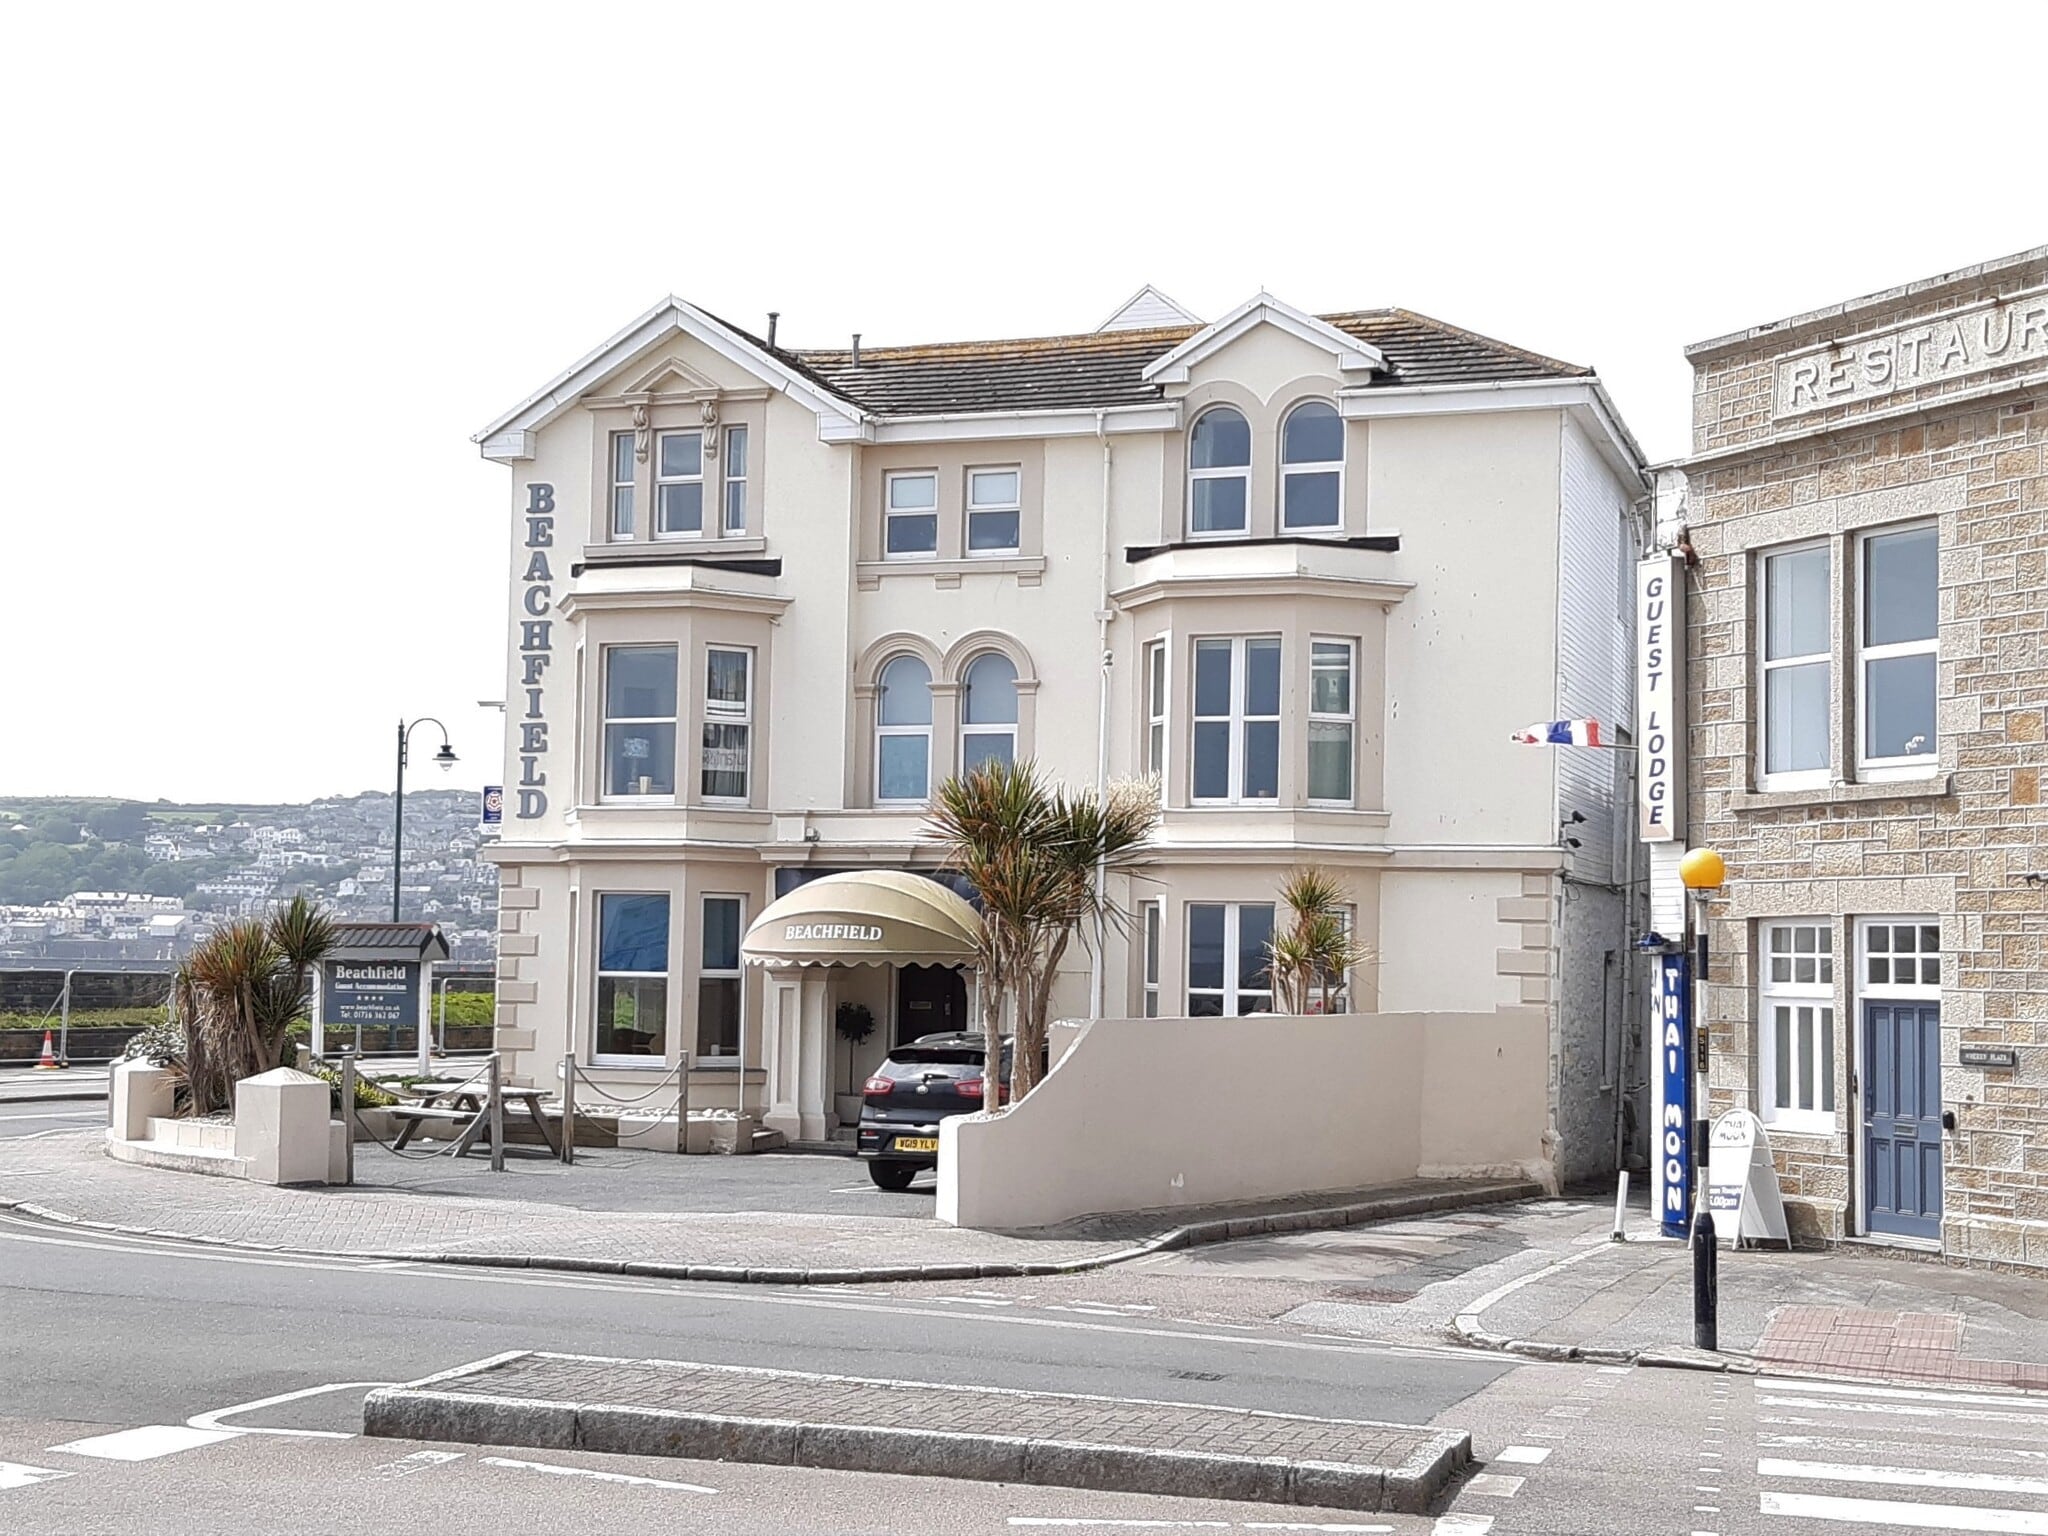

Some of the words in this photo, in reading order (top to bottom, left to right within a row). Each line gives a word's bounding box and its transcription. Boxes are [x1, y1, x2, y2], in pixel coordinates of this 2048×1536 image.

[1791, 306, 2048, 407] RESTAUR
[517, 482, 556, 820] BEACHFIELD
[1646, 576, 1664, 692] GUEST
[1648, 711, 1666, 825] LODGE
[335, 965, 407, 980] Beachfield
[785, 924, 883, 941] BEACHFIELD
[1665, 968, 1680, 1074] THAI
[1664, 1103, 1682, 1211] MOON
